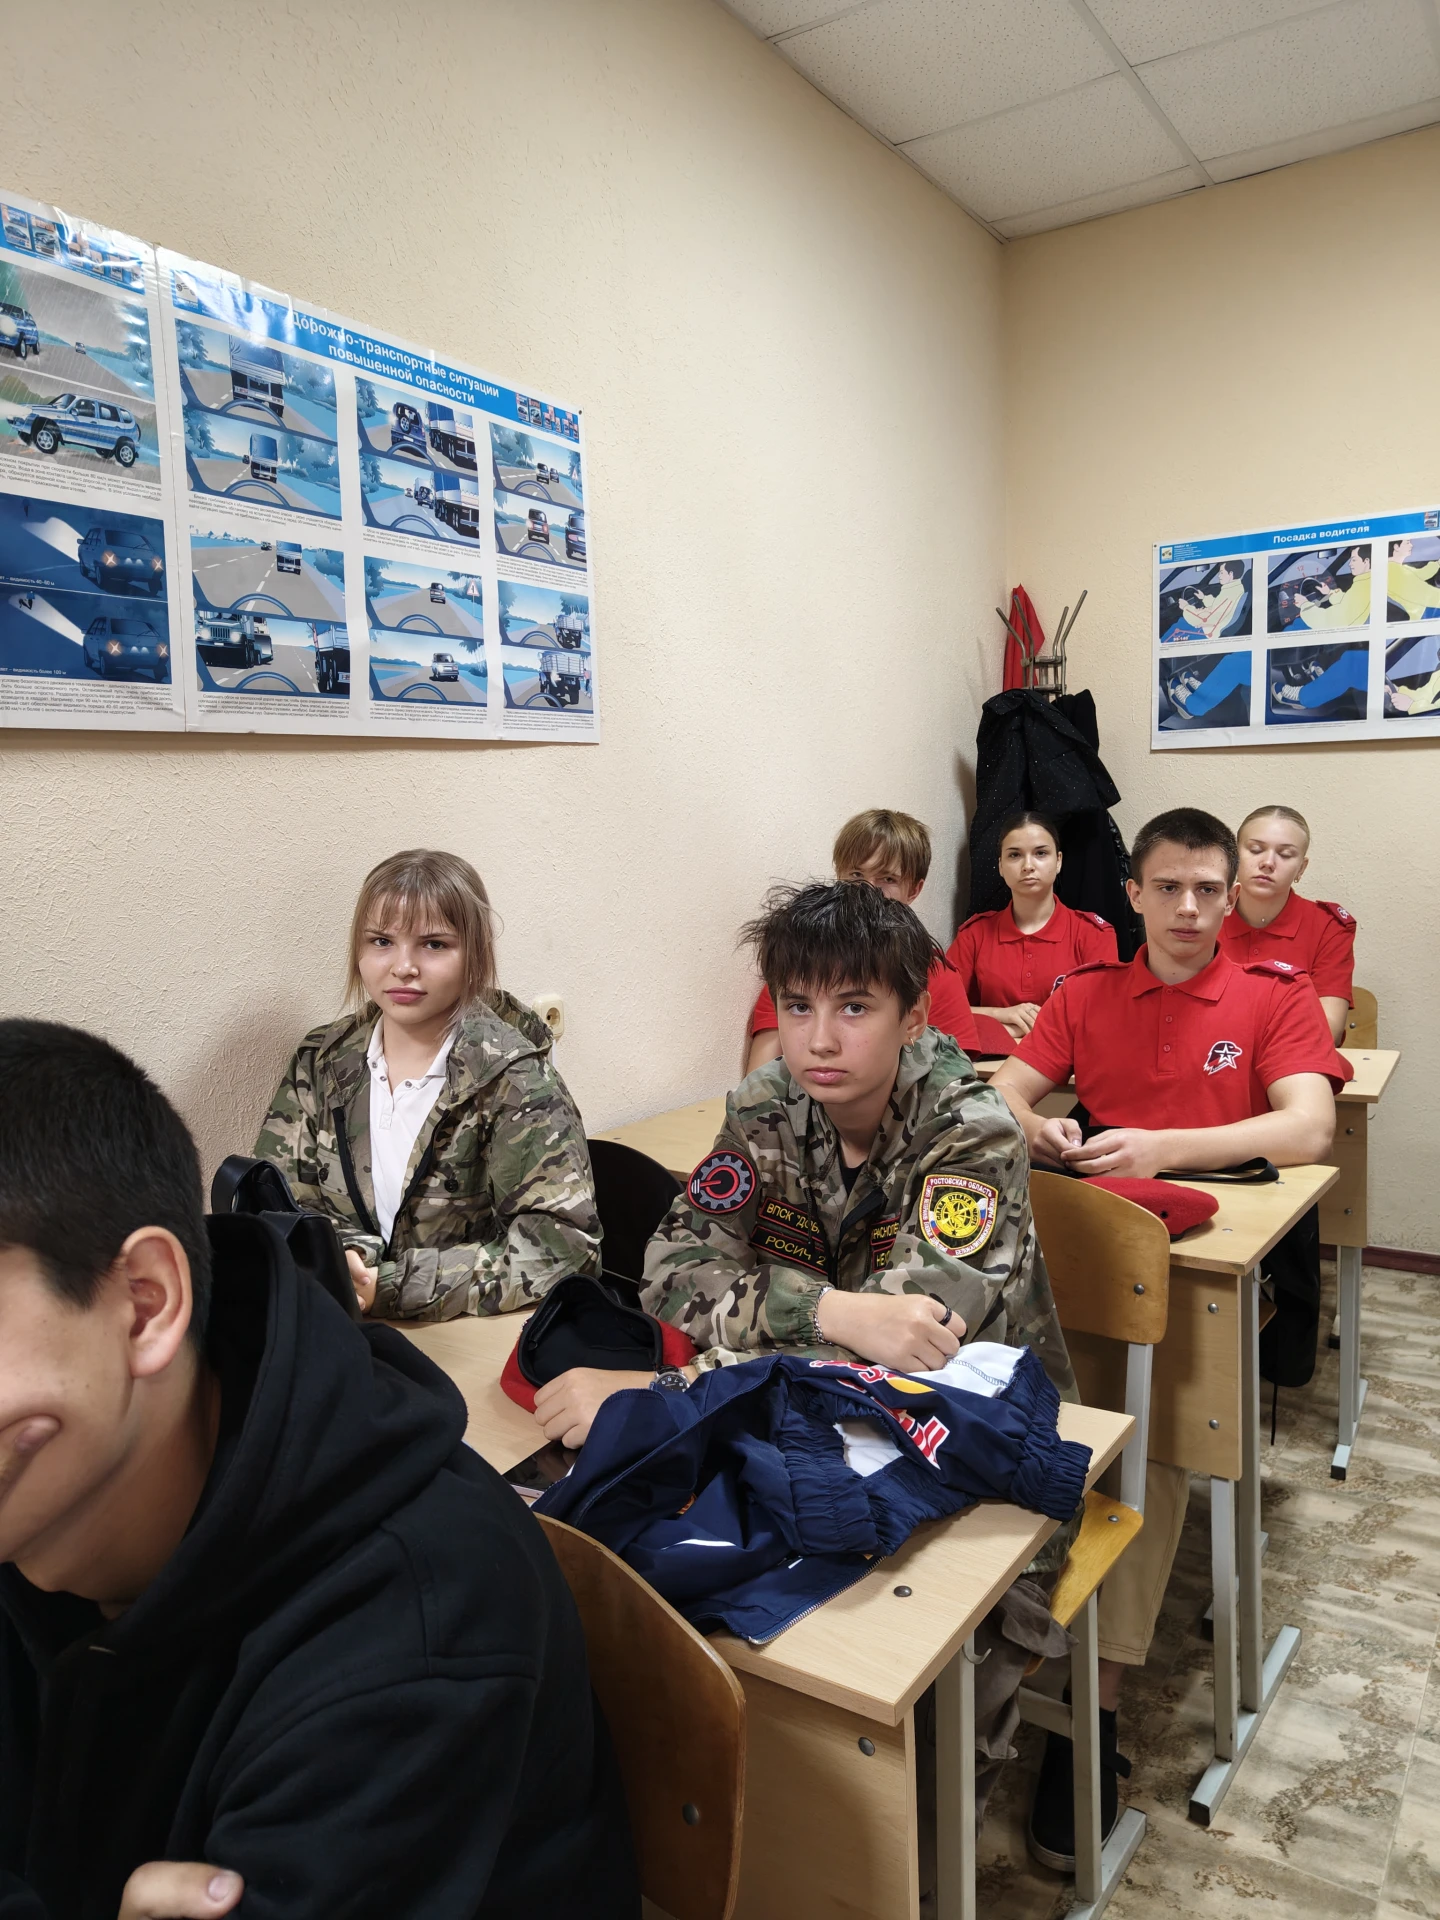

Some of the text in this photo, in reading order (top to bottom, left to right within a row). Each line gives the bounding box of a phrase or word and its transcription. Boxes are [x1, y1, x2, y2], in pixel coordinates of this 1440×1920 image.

[292, 311, 499, 398] Дорожно-транспортные ситуации
[328, 344, 475, 404] повышенной опасности
[1273, 525, 1370, 544] Посадка водителя
[930, 1178, 992, 1197] РОСТОВСКАЯ ОБЛАСТЬ
[948, 1194, 972, 1205] ОТВАГА
[766, 1203, 795, 1222] ВПСК
[936, 1200, 946, 1221] СЛАВА
[765, 1235, 826, 1266] РОСИЧ 2
